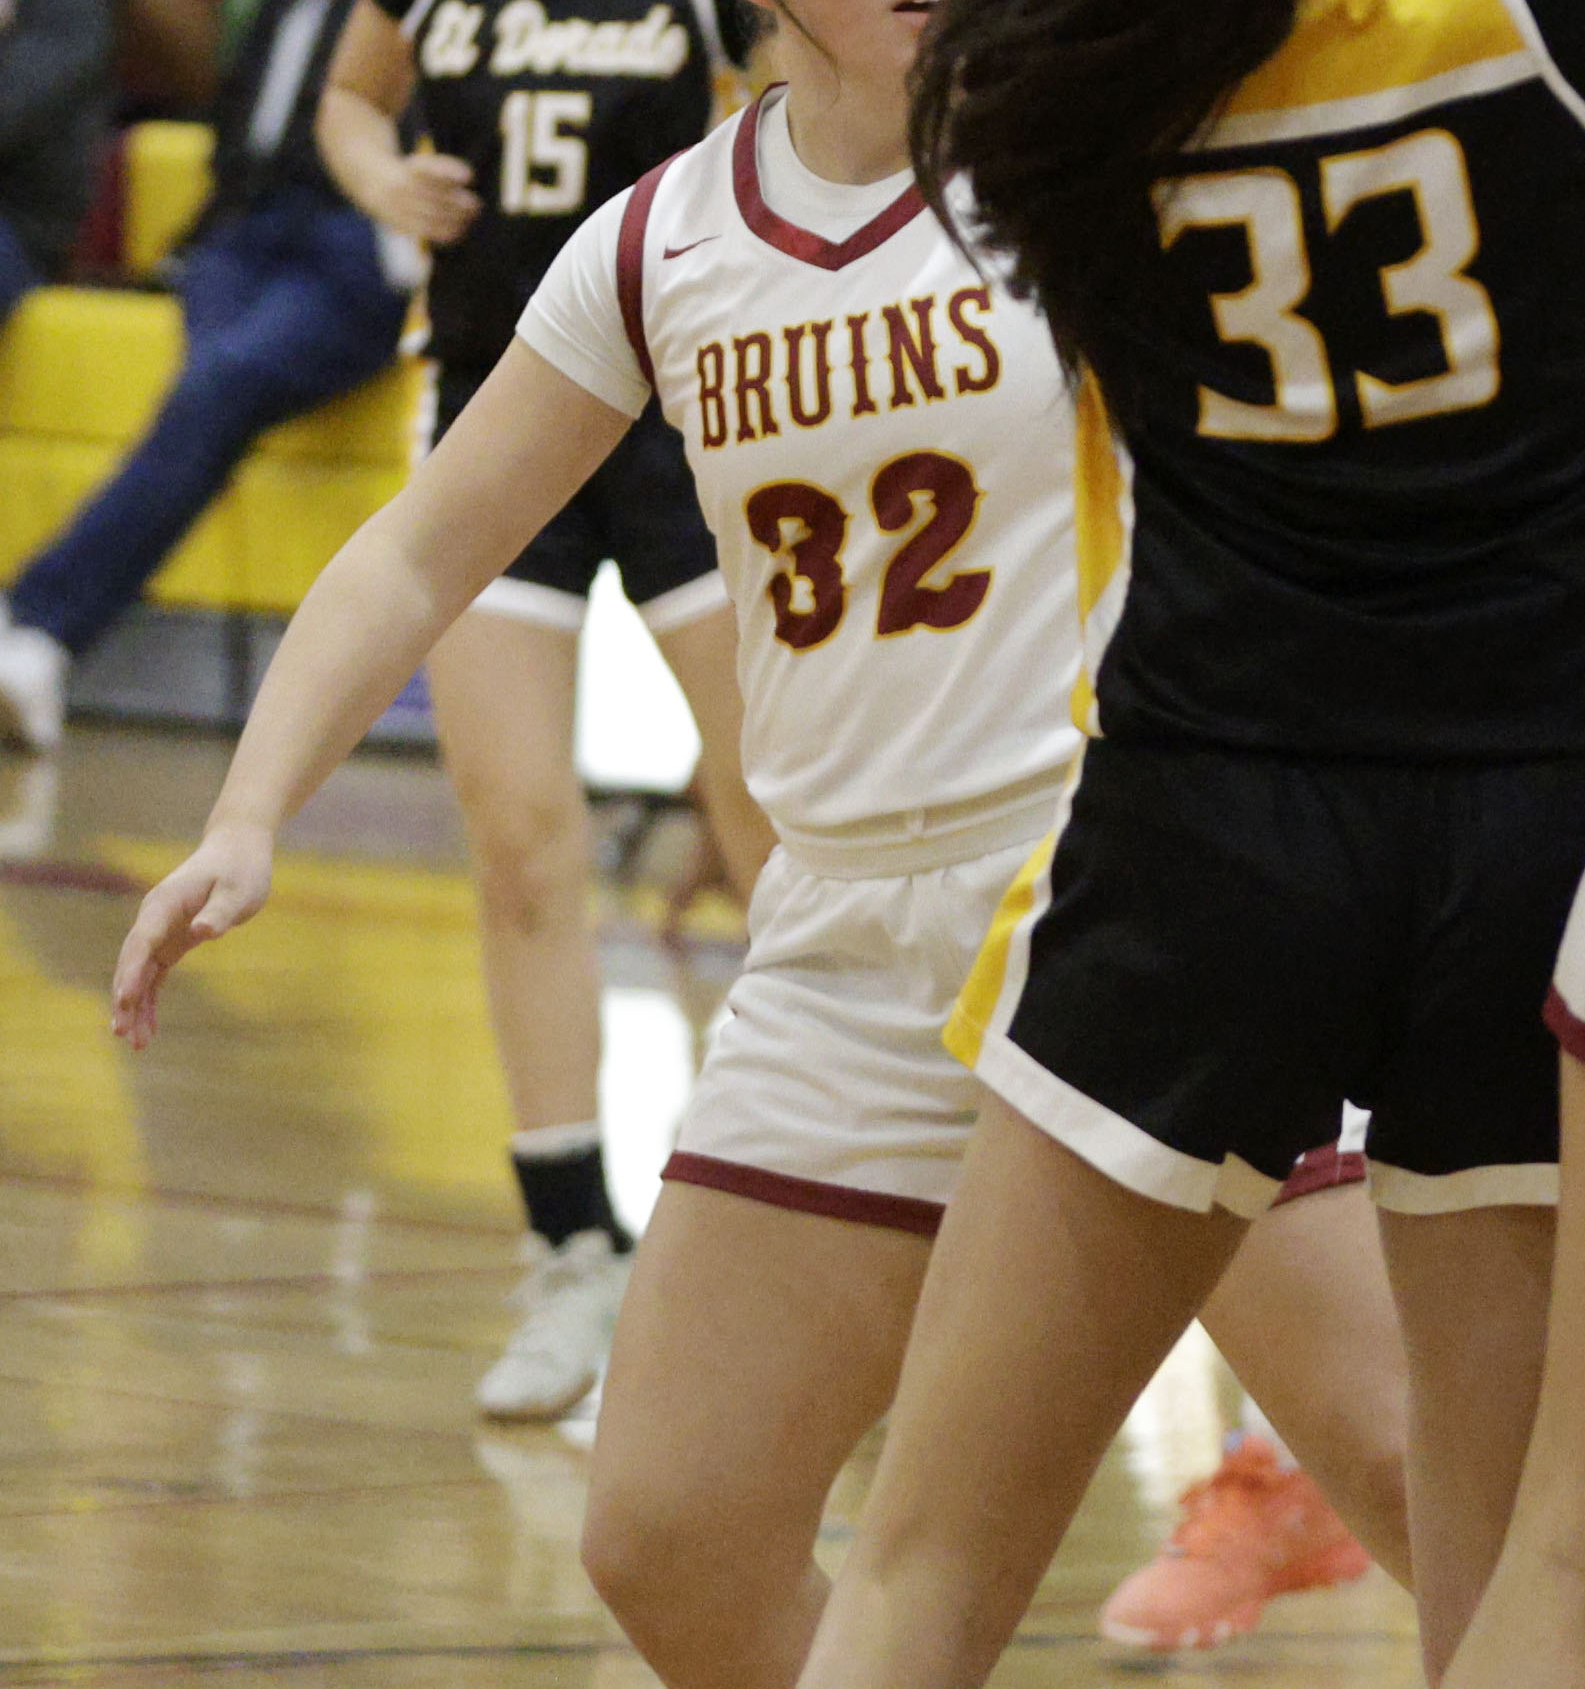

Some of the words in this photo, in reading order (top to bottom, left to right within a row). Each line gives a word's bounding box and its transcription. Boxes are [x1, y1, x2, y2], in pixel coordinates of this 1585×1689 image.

[502, 89, 594, 215] 15
[696, 283, 1001, 451] BRUINS
[1150, 127, 1501, 443] 33
[742, 447, 996, 654] 32
